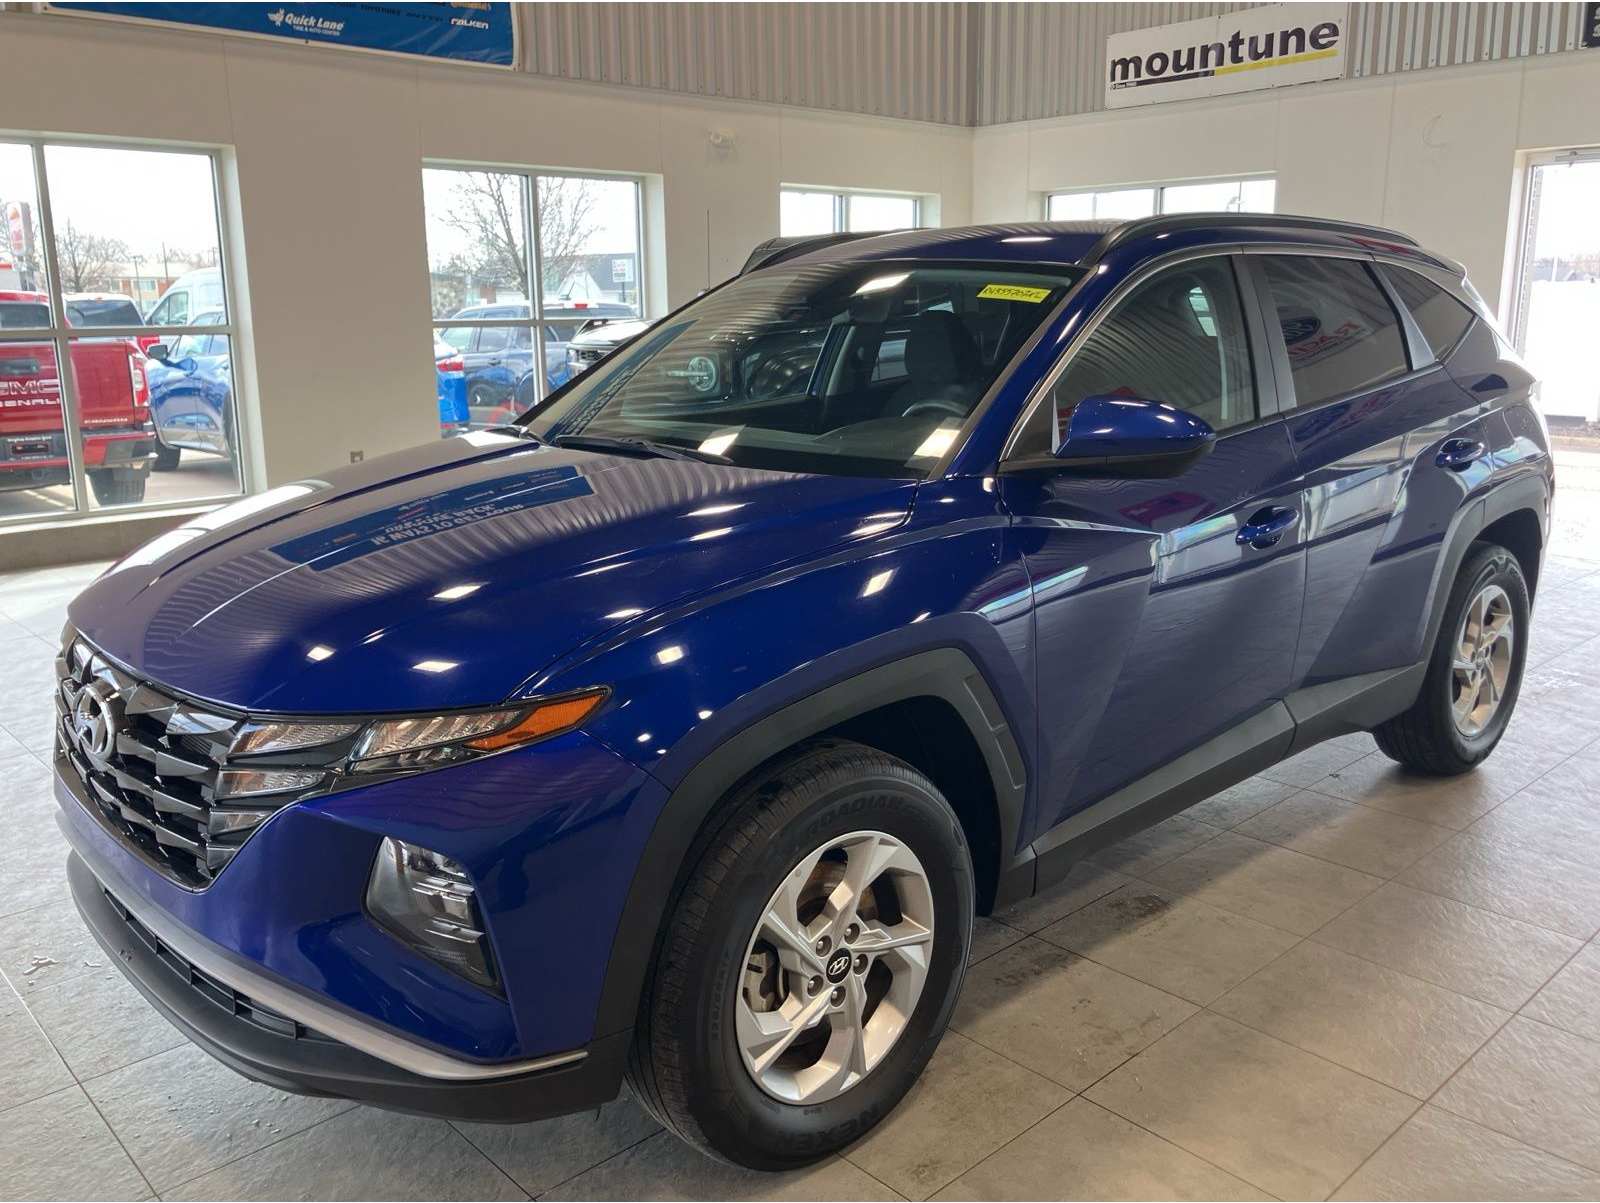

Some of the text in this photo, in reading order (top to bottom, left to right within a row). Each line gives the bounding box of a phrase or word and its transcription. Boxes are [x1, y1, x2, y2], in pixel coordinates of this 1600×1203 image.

[285, 13, 344, 31] Quick Lane
[451, 18, 489, 29] FALKEN
[1110, 22, 1340, 82] mountune
[0, 398, 60, 407] ENALI
